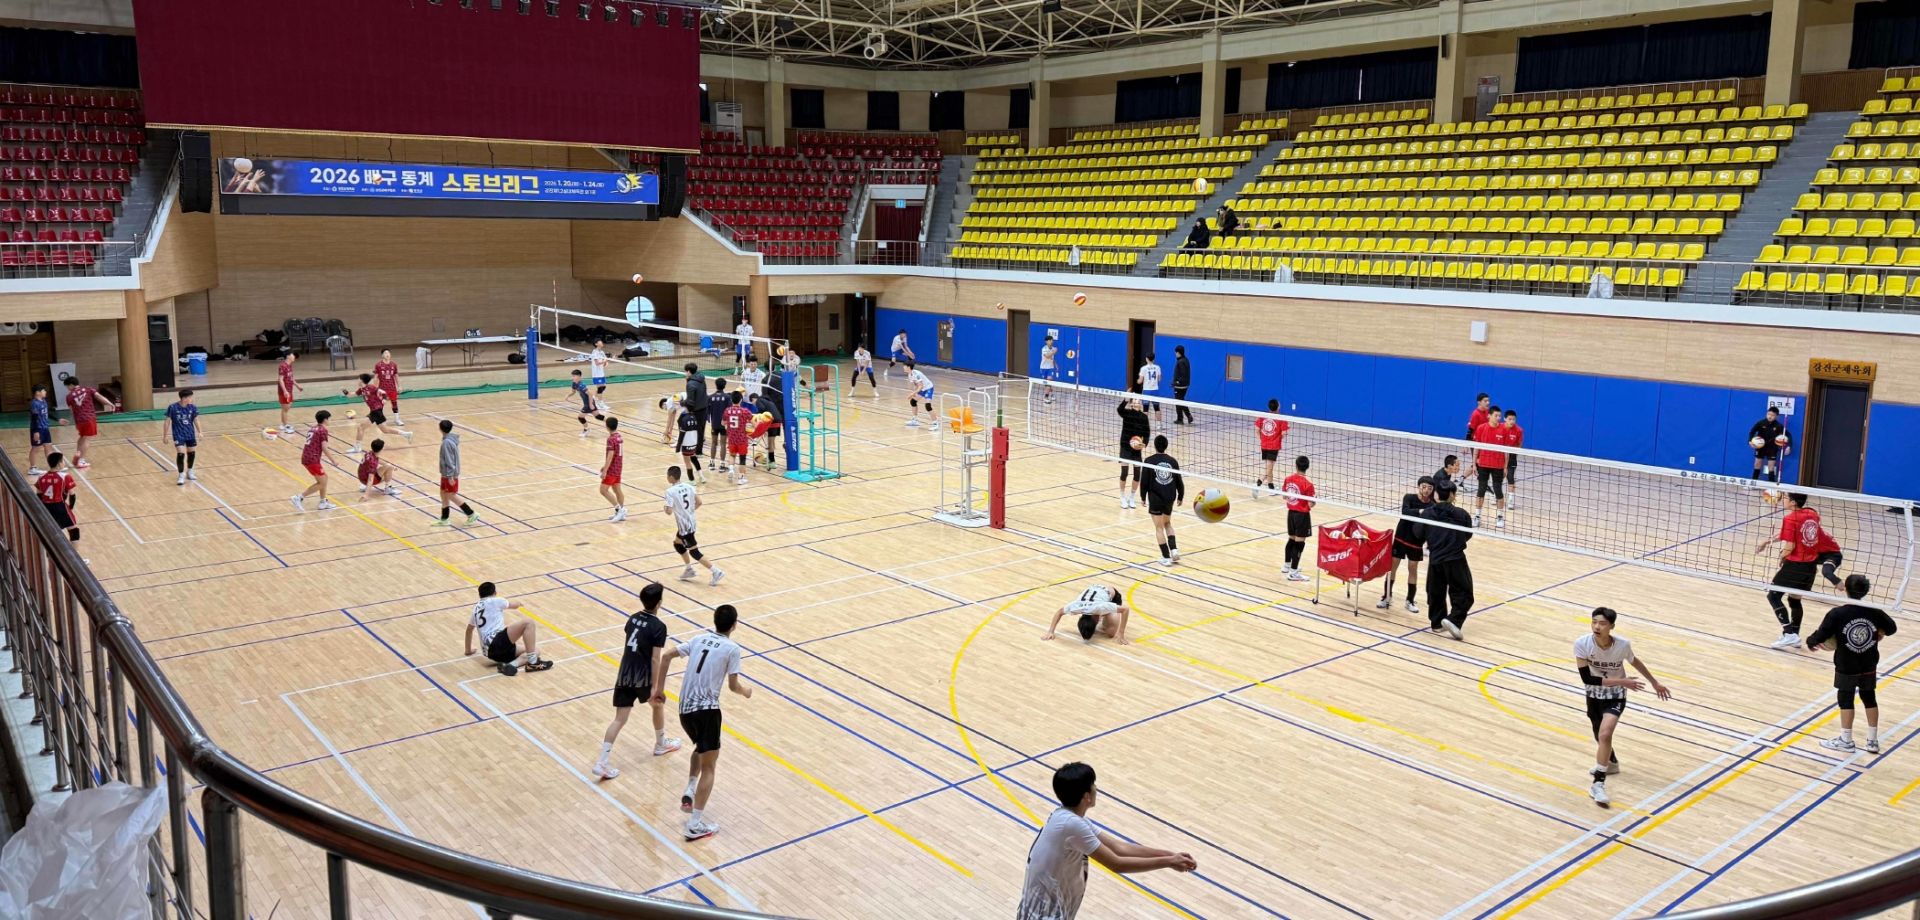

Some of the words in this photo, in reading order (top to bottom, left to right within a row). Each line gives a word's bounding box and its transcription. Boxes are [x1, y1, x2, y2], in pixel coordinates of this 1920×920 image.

[310, 167, 360, 185] 2026
[363, 169, 398, 186] 배구
[401, 170, 434, 187] 동계
[442, 173, 540, 194] 스토브리그
[1813, 362, 1872, 377] 강진군체육회
[729, 415, 739, 428] 5
[44, 484, 54, 499] 4
[683, 493, 690, 510] 5
[627, 628, 639, 652] 4
[696, 648, 710, 674] 1
